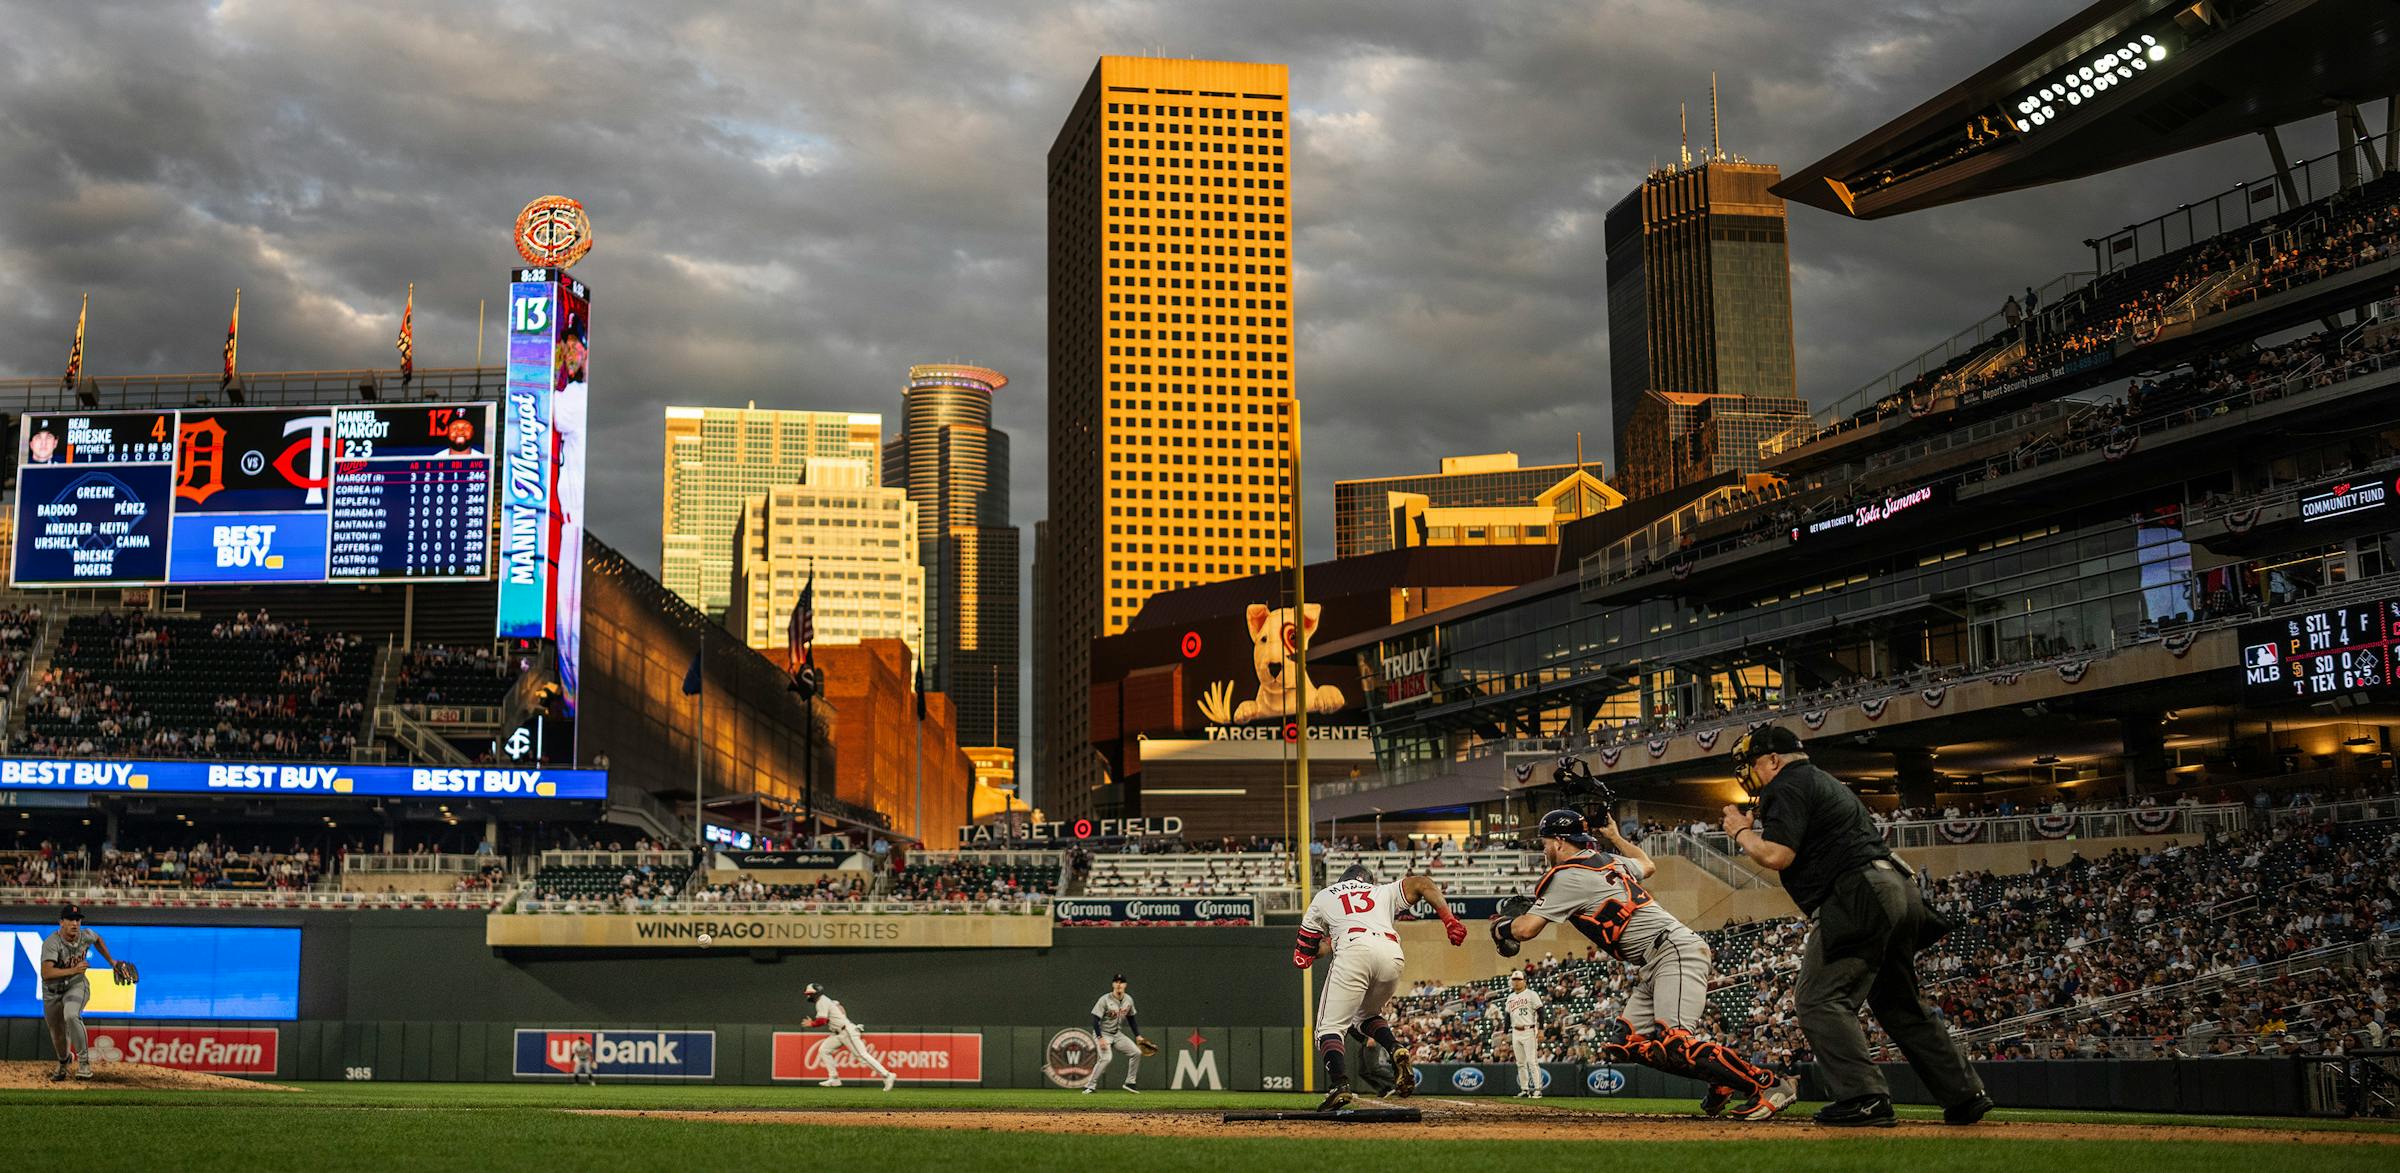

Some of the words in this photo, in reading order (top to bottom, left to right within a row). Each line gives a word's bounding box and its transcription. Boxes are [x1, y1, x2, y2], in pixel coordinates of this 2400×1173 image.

[521, 269, 546, 282] 8:32
[515, 297, 550, 333] 13
[1983, 386, 2003, 400] Report
[2003, 378, 2029, 393] Security
[2051, 365, 2065, 378] Text
[68, 418, 89, 429] BEAU
[151, 415, 166, 442] 4
[337, 410, 376, 424] MANUEL
[427, 408, 453, 437] 13
[337, 421, 390, 439] MARGOT
[67, 428, 112, 444] BRIESKE
[75, 444, 104, 454] PITCHES
[345, 440, 373, 458] 2-3
[511, 392, 548, 501] Margot
[107, 453, 114, 462] 0
[121, 453, 128, 462] 0
[135, 453, 142, 461] 0
[149, 453, 156, 461] 0
[163, 452, 170, 461] 0
[247, 456, 258, 469] VS
[336, 473, 372, 483] MARGOT
[411, 472, 417, 482] 3
[424, 472, 430, 482] 2
[438, 472, 444, 482] 2
[76, 486, 115, 499] GREENE
[336, 485, 370, 495] CORREA
[410, 484, 416, 494] 3
[423, 484, 430, 494] 0
[437, 483, 444, 493] 0
[451, 483, 459, 493] 0
[114, 500, 145, 515] PÉREZ
[335, 497, 369, 506] KEPLER
[423, 495, 430, 506] 0
[436, 495, 444, 505] 0
[451, 495, 458, 505] 0
[2302, 493, 2358, 517] COMMUNITY
[2359, 487, 2385, 504] FUND
[37, 503, 78, 517] BADDOO
[334, 508, 374, 518] MIRANDA
[409, 507, 415, 517] 3
[422, 507, 430, 517] 0
[436, 507, 443, 517] 0
[450, 506, 458, 516] 0
[1810, 524, 1818, 534] GET
[1819, 519, 1832, 532] YOUR
[1831, 515, 1848, 528] TICKET
[1847, 514, 1854, 523] TO
[1882, 487, 1931, 519] Summers
[45, 522, 92, 536] KREIDLER
[100, 522, 129, 535] KEITH
[334, 520, 374, 530] SANTANA
[408, 519, 415, 529] 3
[422, 519, 429, 529] 0
[435, 518, 442, 528] 0
[450, 518, 457, 528] 0
[35, 537, 78, 549] URSHELA
[116, 535, 150, 548] CANHA
[213, 525, 276, 547] BEST
[333, 532, 368, 541] BUXTON
[408, 530, 414, 540] 2
[449, 530, 457, 540] 0
[511, 504, 537, 584] MANNY
[73, 549, 114, 562] BRIESKE
[332, 543, 370, 553] JEFFERS
[407, 542, 414, 552] 3
[421, 542, 428, 552] 0
[434, 542, 442, 552] 0
[216, 546, 270, 567] BUY
[332, 555, 367, 565] CASTRO
[407, 554, 413, 564] 2
[420, 554, 428, 564] 0
[434, 553, 441, 564] 0
[448, 553, 456, 563] 0
[73, 563, 112, 576] ROGERS
[331, 567, 366, 576] FARMER
[406, 565, 413, 576] 2
[448, 565, 455, 575] 0
[2306, 613, 2331, 633] STL
[2338, 609, 2347, 627] 7
[2360, 613, 2369, 631] F
[2291, 639, 2300, 655] P
[2310, 630, 2331, 650] PIT
[2340, 628, 2349, 646] 4
[1383, 646, 1431, 681] TRULY
[2316, 654, 2334, 674] SD
[2342, 651, 2352, 670] 0
[2363, 665, 2371, 677] 5
[2246, 665, 2281, 686] MLB
[2310, 672, 2336, 693] TEX
[2344, 671, 2353, 688] 6
[1204, 726, 1281, 740] TARGET
[1306, 726, 1382, 740] CENTE
[1, 761, 72, 785] BEST
[74, 762, 133, 786] BUY
[208, 765, 277, 788] BEST
[280, 767, 338, 789] BUY
[412, 769, 482, 792] BEST
[484, 770, 541, 793] BUY
[1488, 813, 1519, 825] TRLY
[959, 821, 1066, 841] TAGET
[1101, 816, 1183, 836] FIELD
[1057, 901, 1112, 920] Corona
[1125, 900, 1181, 920] Corona
[1195, 900, 1250, 920] Corona
[1338, 890, 1375, 916] 13
[1410, 896, 1467, 919] Cona
[637, 922, 765, 939] WINNEBAGO
[766, 923, 900, 939] INDUSTRIES
[595, 1033, 678, 1064] bank
[887, 1050, 949, 1069] SPORTS
[1066, 1050, 1081, 1065] W
[345, 1066, 372, 1080] 365
[1170, 1049, 1222, 1090] M
[1263, 1077, 1293, 1089] 328
[1459, 1071, 1478, 1088] Ford
